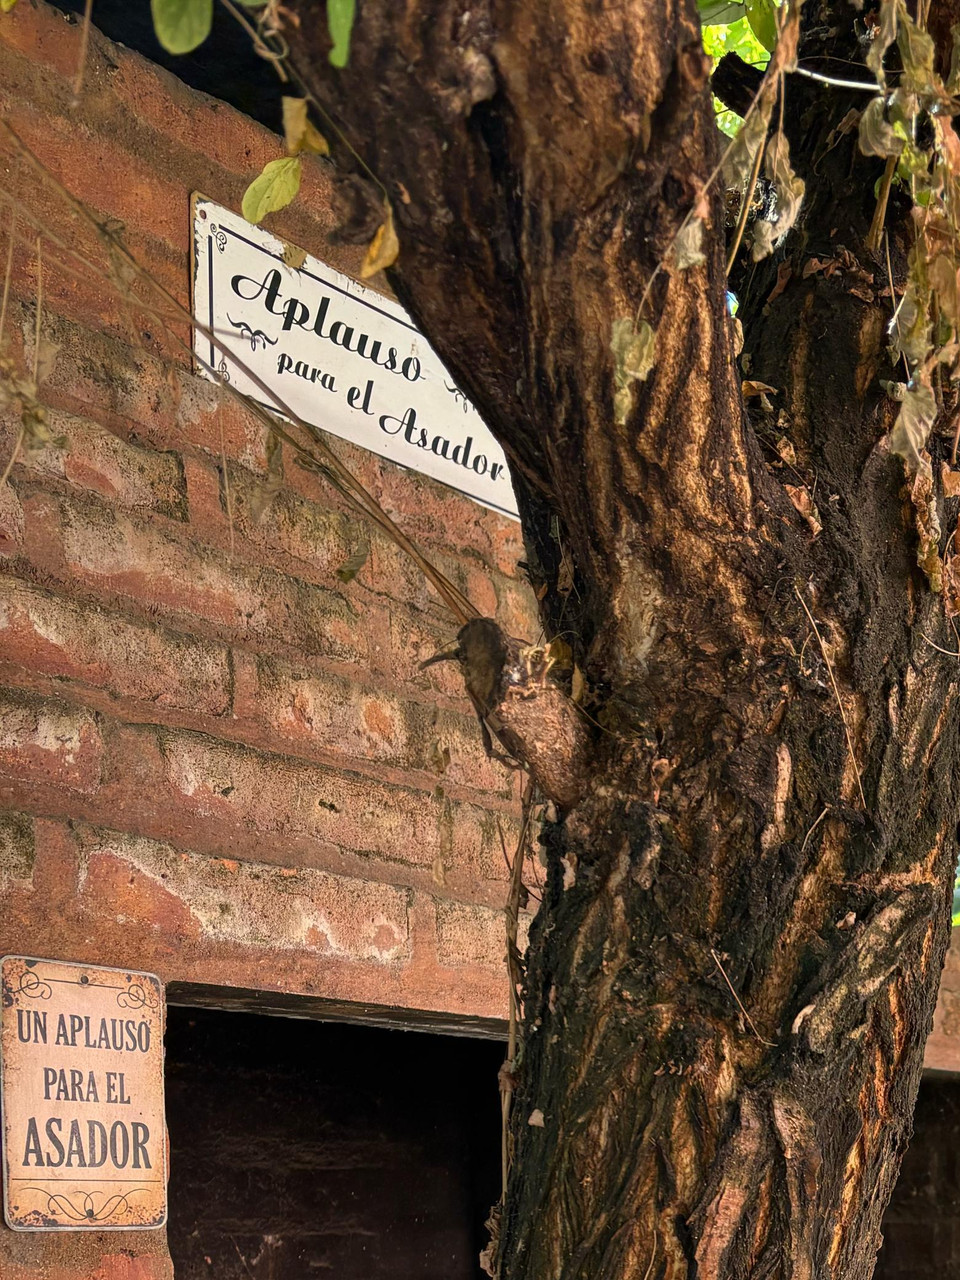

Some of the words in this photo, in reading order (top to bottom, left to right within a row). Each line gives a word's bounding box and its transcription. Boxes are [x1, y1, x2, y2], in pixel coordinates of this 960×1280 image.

[230, 268, 426, 382] Aplauso
[276, 353, 338, 393] para
[346, 380, 375, 416] el
[378, 407, 505, 481] Asador
[16, 1008, 48, 1044] UN
[54, 1013, 151, 1053] APLAUSO
[43, 1067, 100, 1103] PARA
[105, 1072, 131, 1105] EL
[21, 1116, 152, 1169] ASADOR
